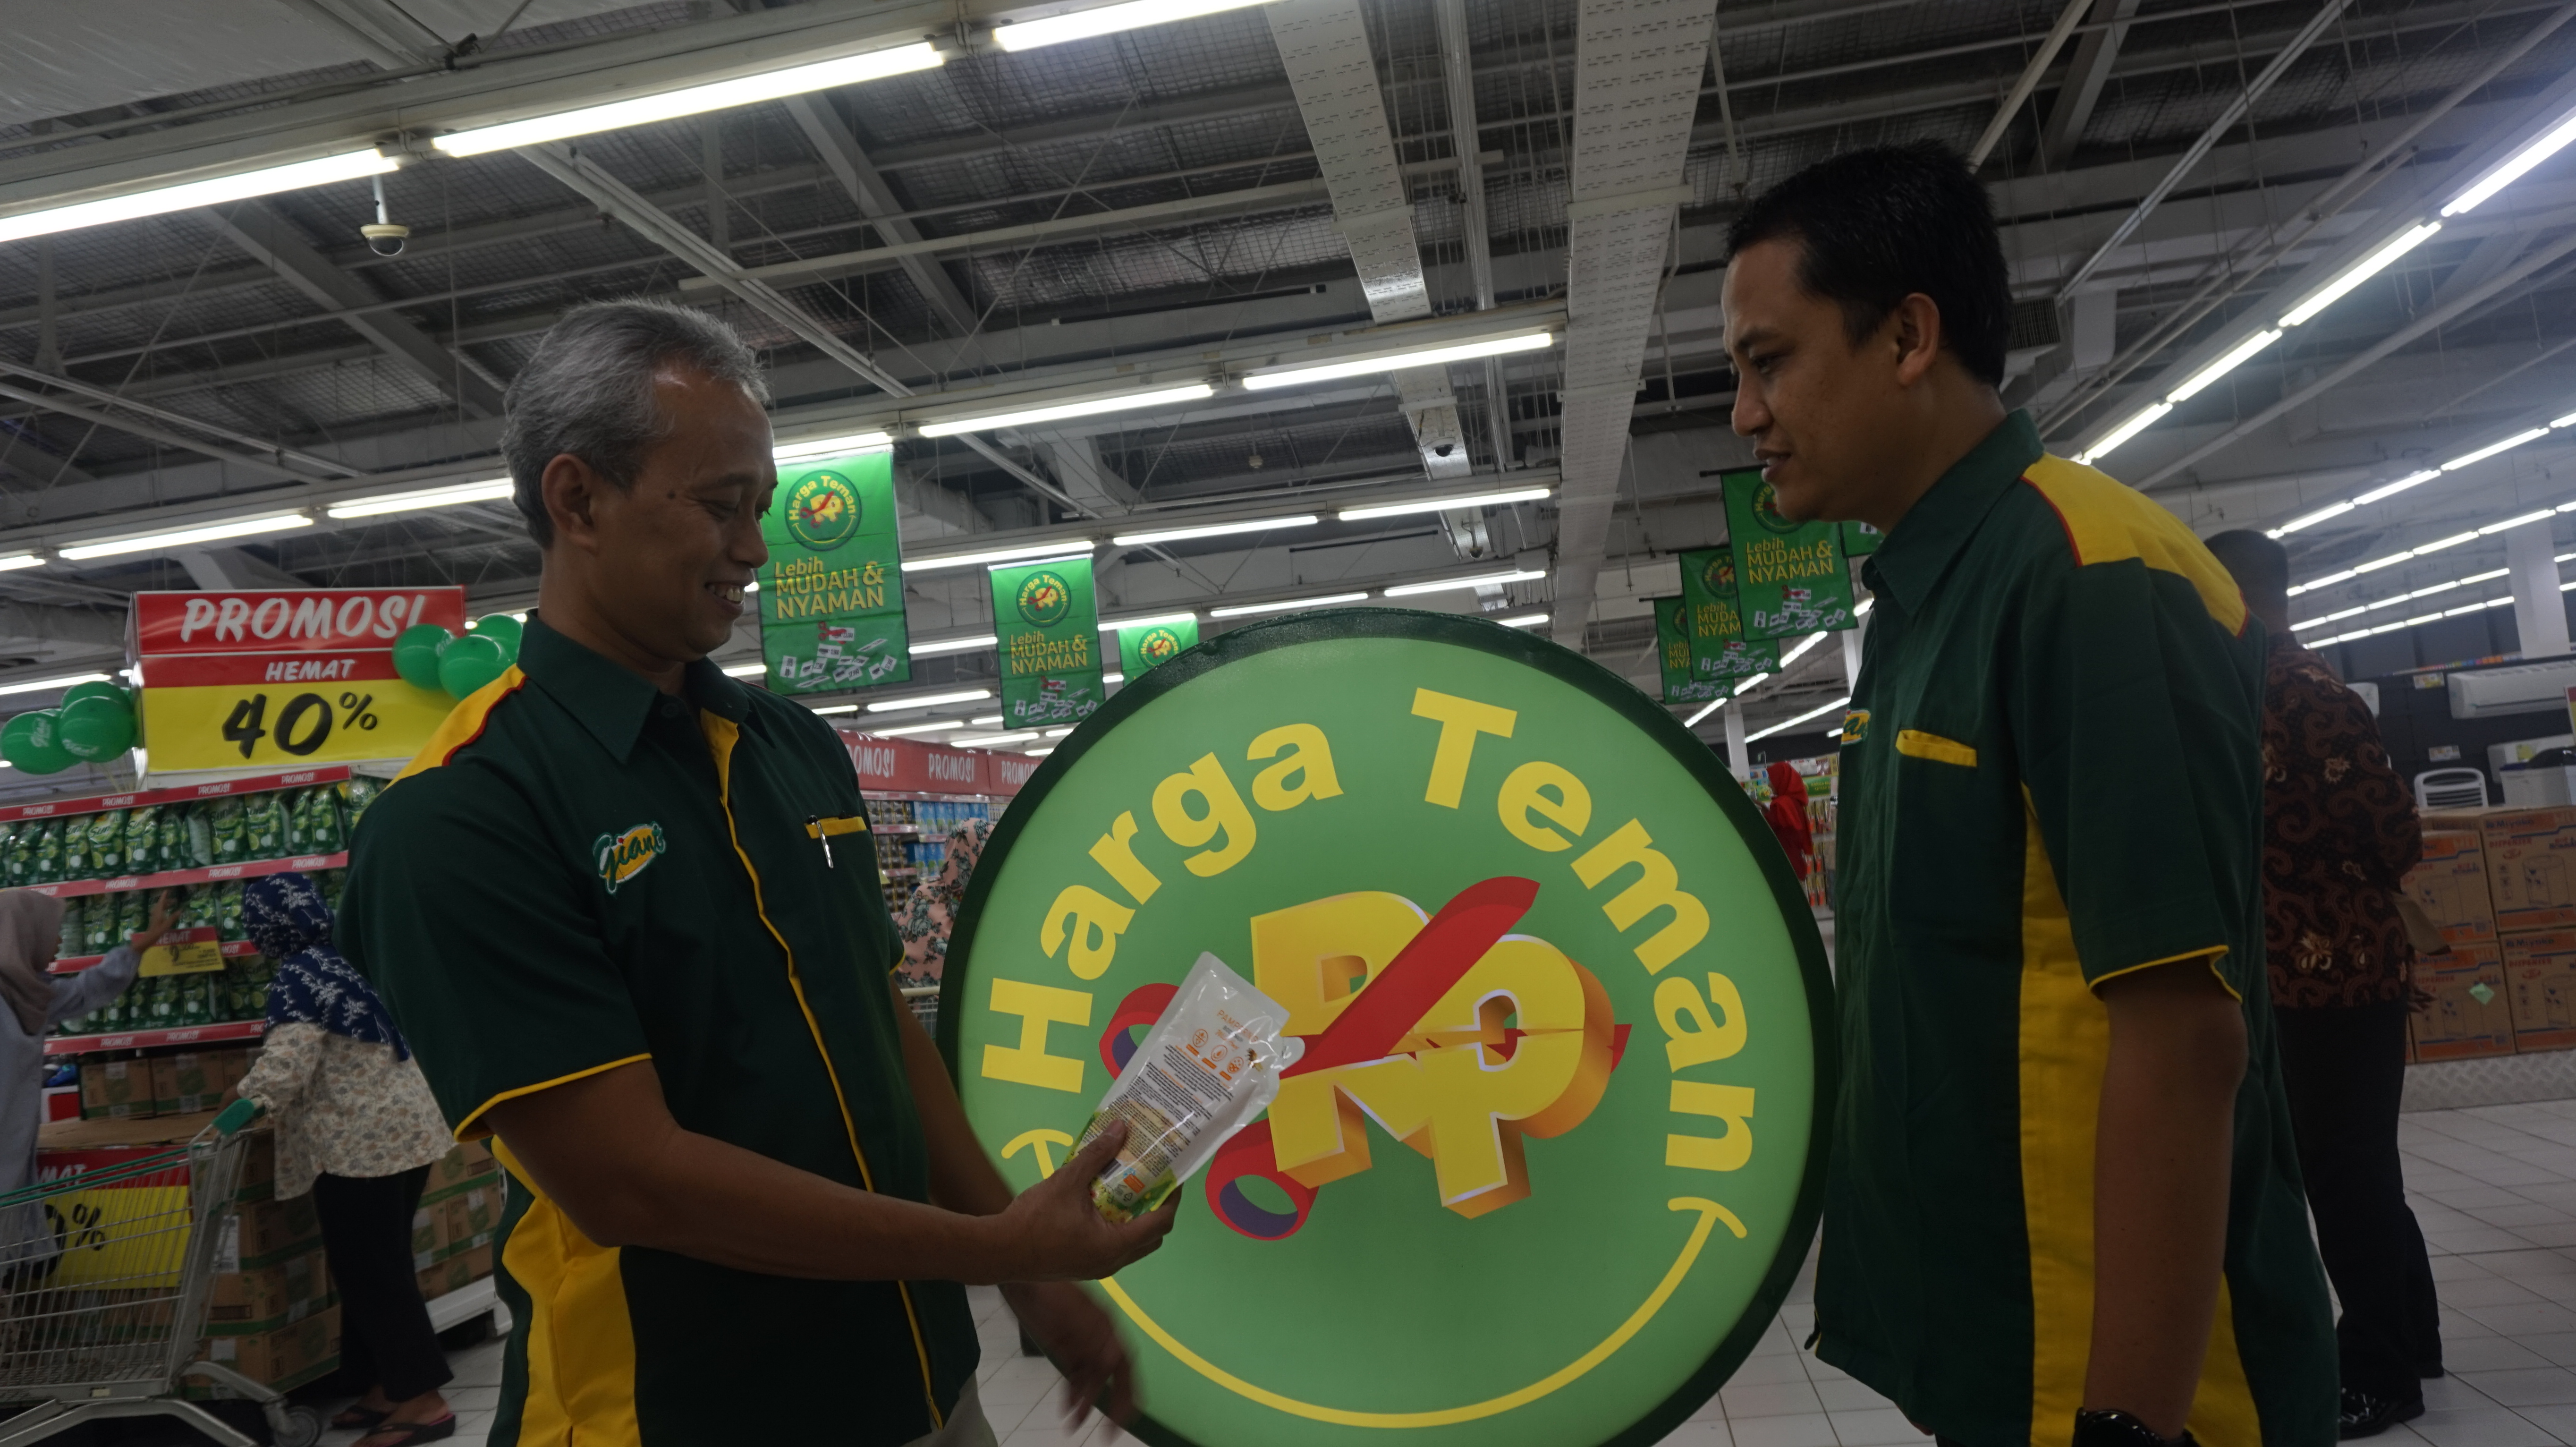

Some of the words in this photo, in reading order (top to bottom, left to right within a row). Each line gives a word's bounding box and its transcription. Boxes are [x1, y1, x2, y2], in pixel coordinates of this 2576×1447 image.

[789, 481, 817, 520] Harga
[821, 476, 856, 514] Teman
[1755, 486, 1772, 511] Harg
[1746, 537, 1785, 554] Lebih
[1747, 546, 1813, 568] MUDAH
[1816, 540, 1833, 558] &
[775, 556, 823, 578] Lebih
[776, 568, 858, 596] MUDAH
[863, 561, 884, 586] &
[1749, 558, 1834, 584] NYAMAN
[777, 586, 884, 620] NYAMAN
[1019, 578, 1040, 606] Harga
[1042, 575, 1068, 602] Teman
[180, 594, 425, 643] PROMOSI
[1697, 602, 1727, 614] Lebih
[1698, 610, 1739, 625] MUDA
[1010, 630, 1044, 646] Lebih
[1698, 621, 1742, 638] NYAM
[1011, 639, 1069, 659] MUDAH
[1072, 634, 1088, 652] &
[265, 659, 356, 681] HEMAT
[1011, 652, 1087, 675] NYAMAN
[221, 691, 378, 759] 40%
[928, 753, 975, 783] PROMOSI
[198, 783, 231, 794] PROMOSI
[281, 772, 315, 784] PROMOSI
[105, 878, 137, 890] PROMOSI
[208, 866, 242, 879] PROMOSI
[292, 857, 326, 869] PROMOSI
[981, 723, 1344, 1093] Harga
[1411, 687, 1755, 1171] Teman
[100, 1036, 135, 1047] PROMOSI
[166, 1030, 200, 1041] PROMOSI
